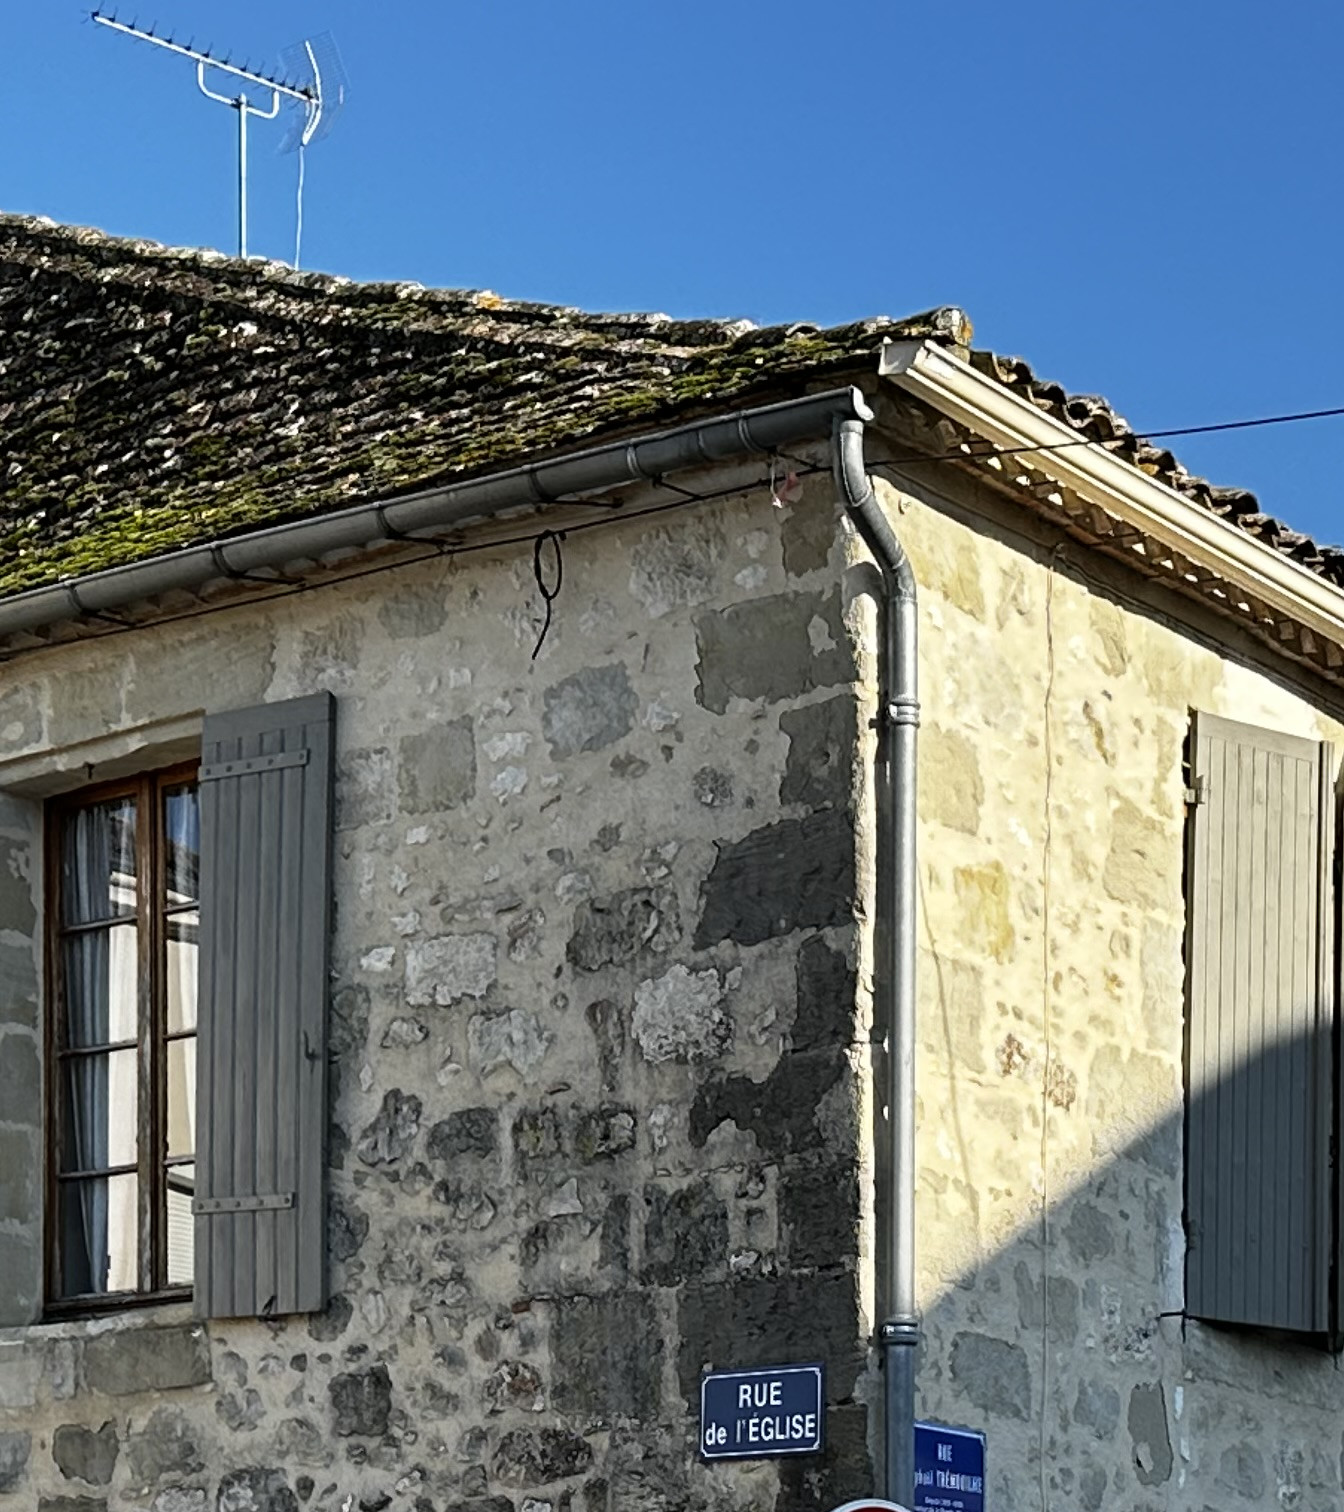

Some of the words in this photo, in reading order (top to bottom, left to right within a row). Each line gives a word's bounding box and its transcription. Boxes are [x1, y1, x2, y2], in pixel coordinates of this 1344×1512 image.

[738, 1381, 783, 1408] RUE
[705, 1421, 727, 1446] de
[736, 1412, 816, 1443] l'ÉGLISE
